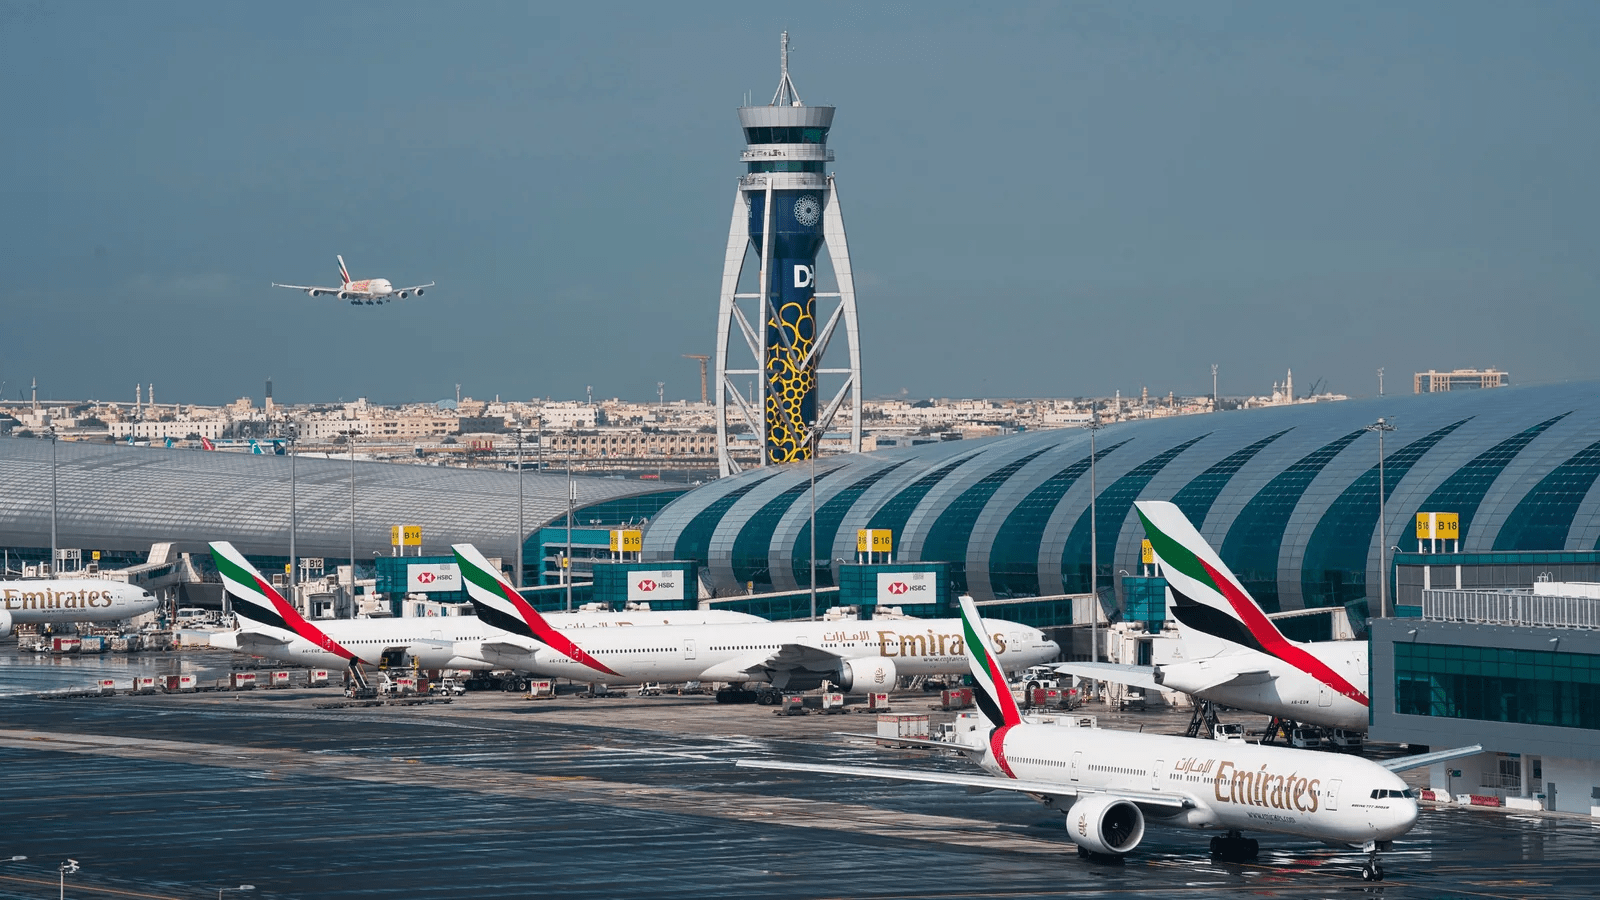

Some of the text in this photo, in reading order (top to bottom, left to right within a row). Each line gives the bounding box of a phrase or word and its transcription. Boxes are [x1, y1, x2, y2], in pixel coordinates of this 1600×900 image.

[1438, 521, 1457, 530] B 18
[624, 537, 630, 545] B
[631, 537, 640, 545] 15
[873, 536, 890, 545] B 16
[67, 550, 78, 558] B11
[309, 559, 322, 567] B12
[3, 587, 112, 610] Emirates
[876, 629, 1006, 657] Emiras
[1214, 761, 1320, 812] Emirates
